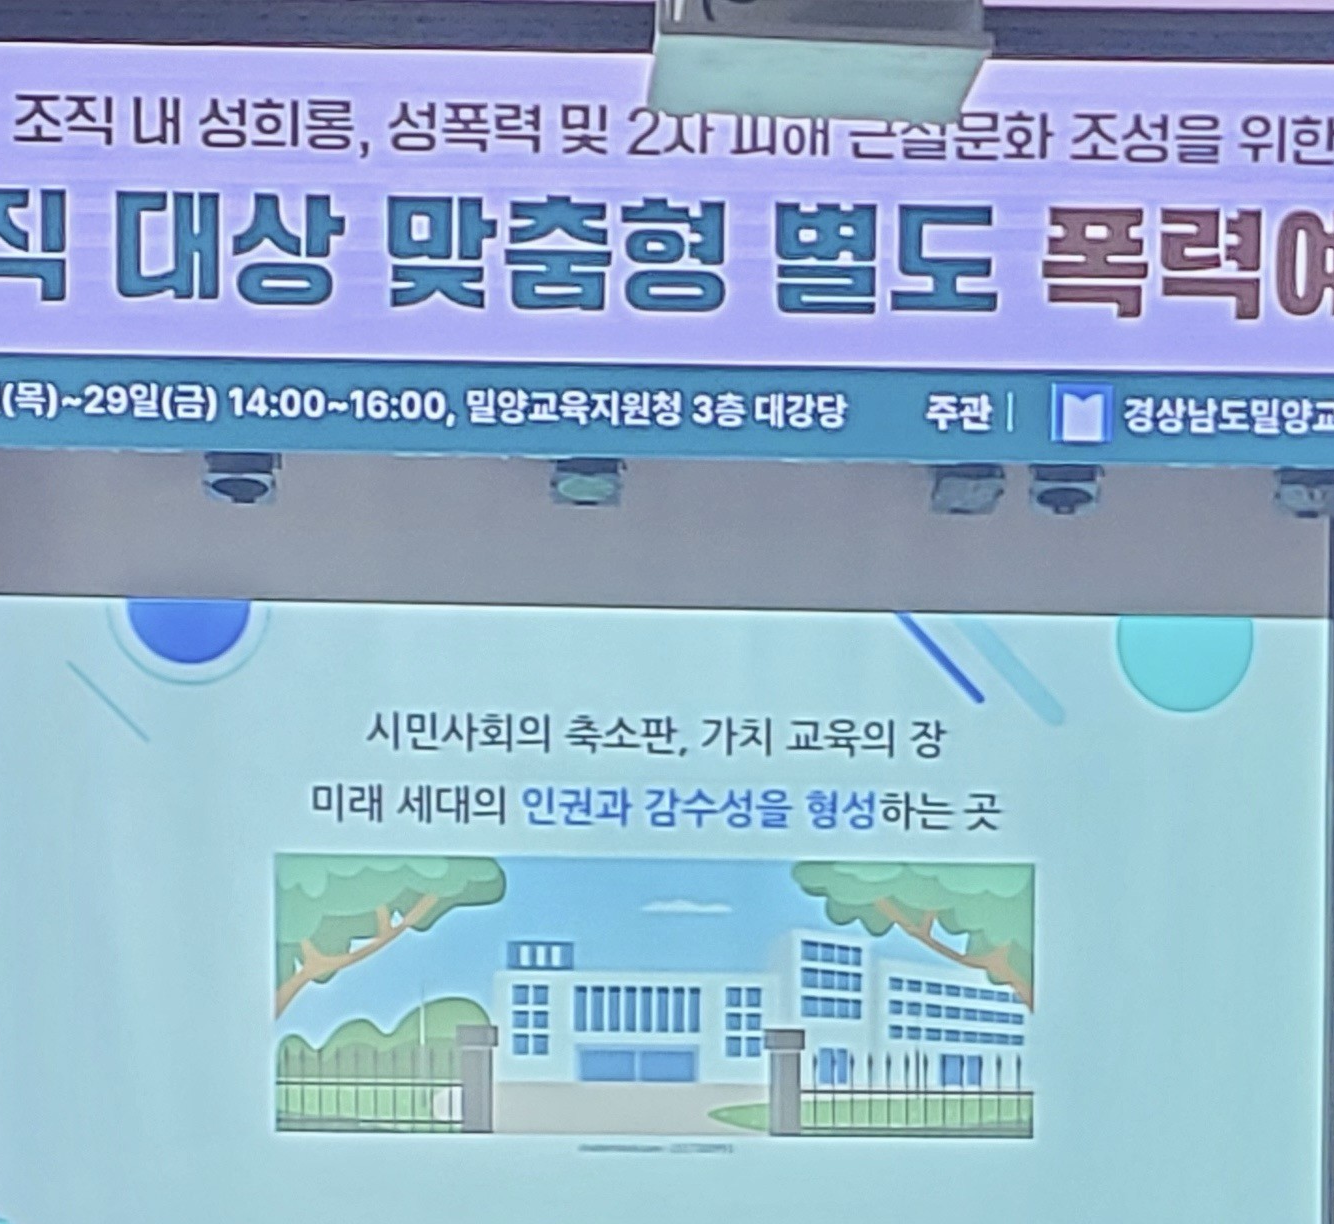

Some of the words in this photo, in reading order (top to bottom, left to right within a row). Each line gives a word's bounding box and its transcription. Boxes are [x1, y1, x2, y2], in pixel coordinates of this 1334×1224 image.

[13, 94, 113, 146] 조직
[133, 96, 180, 145] 내
[199, 98, 369, 159] 성희롱,
[388, 102, 541, 154] 성폭력
[561, 104, 608, 155] 및
[1070, 113, 1223, 164] 조성을
[115, 190, 346, 306] 대상
[387, 194, 726, 313] 맞춤형
[775, 201, 998, 315] 별도
[228, 387, 455, 427] 14:00~16:00,
[467, 388, 681, 426] 밀양교육지원청
[692, 392, 746, 427] 3층
[755, 393, 849, 429] 대강당
[926, 394, 993, 431] 주관
[367, 711, 550, 754] 시민사회의
[565, 715, 688, 757] 축소판,
[702, 717, 772, 757] 가치
[786, 719, 895, 758] 교육의
[910, 720, 948, 759] 장
[312, 783, 383, 823] 미래
[397, 785, 506, 825] 세대의
[522, 786, 633, 827] 인권과
[645, 788, 793, 829] 감수성을
[806, 790, 954, 831] 형성하는
[963, 793, 1002, 831] 곳
